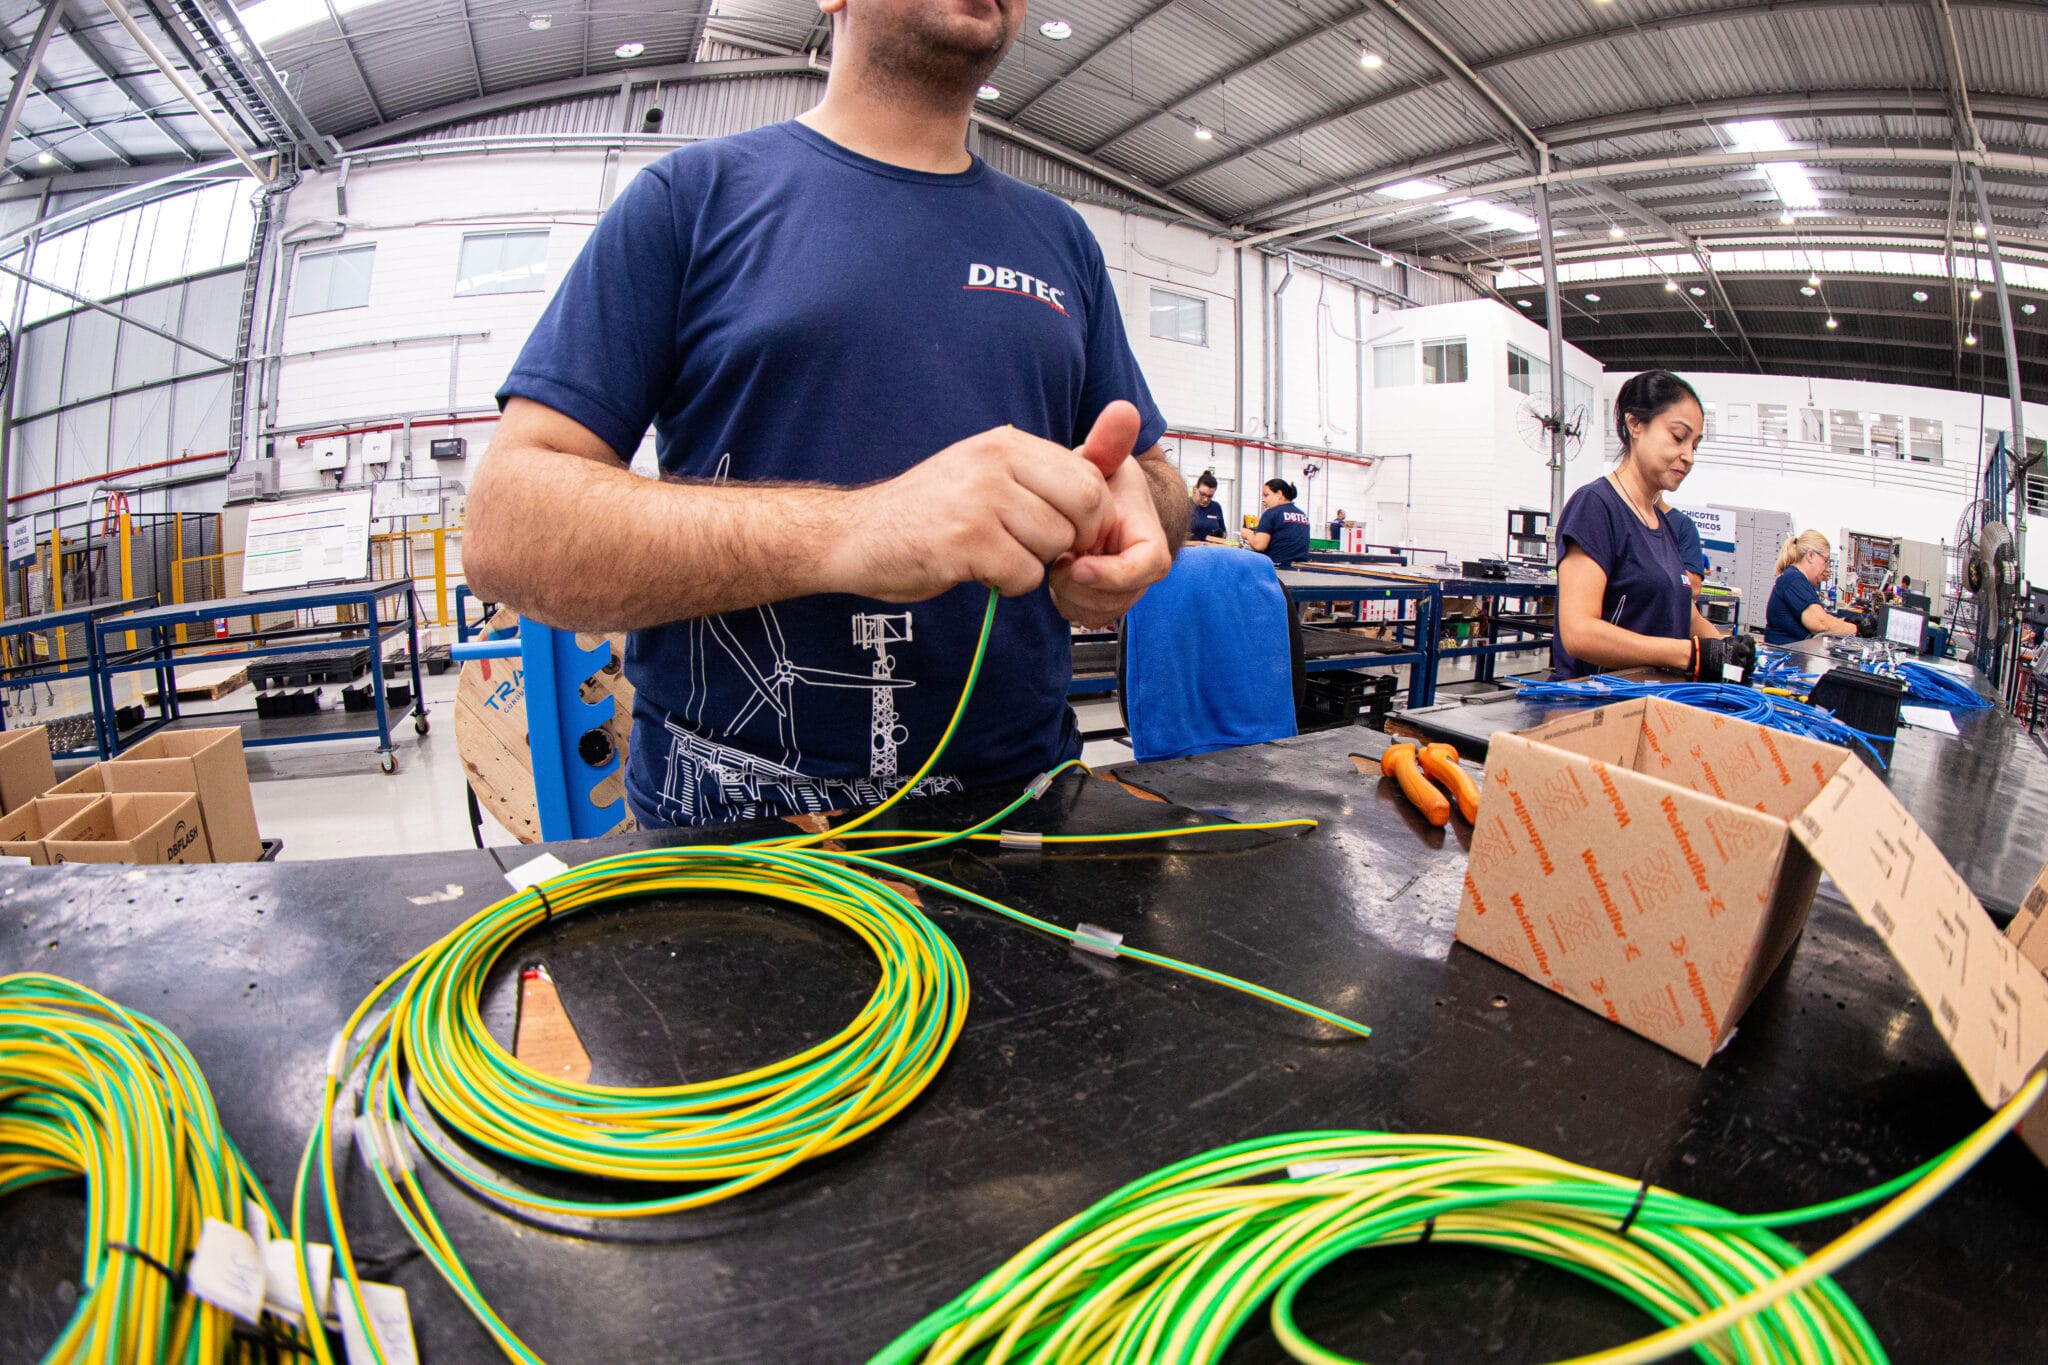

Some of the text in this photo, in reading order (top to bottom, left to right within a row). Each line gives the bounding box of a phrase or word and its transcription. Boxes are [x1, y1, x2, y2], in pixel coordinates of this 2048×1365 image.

[967, 263, 1065, 310] DBTEC
[167, 825, 199, 861] DBFLASH
[1508, 790, 1556, 877] Weidmüller
[1660, 795, 1711, 892] Weidmüller
[1510, 892, 1552, 976] Weidmüller
[1581, 848, 1627, 939] Weidmüller
